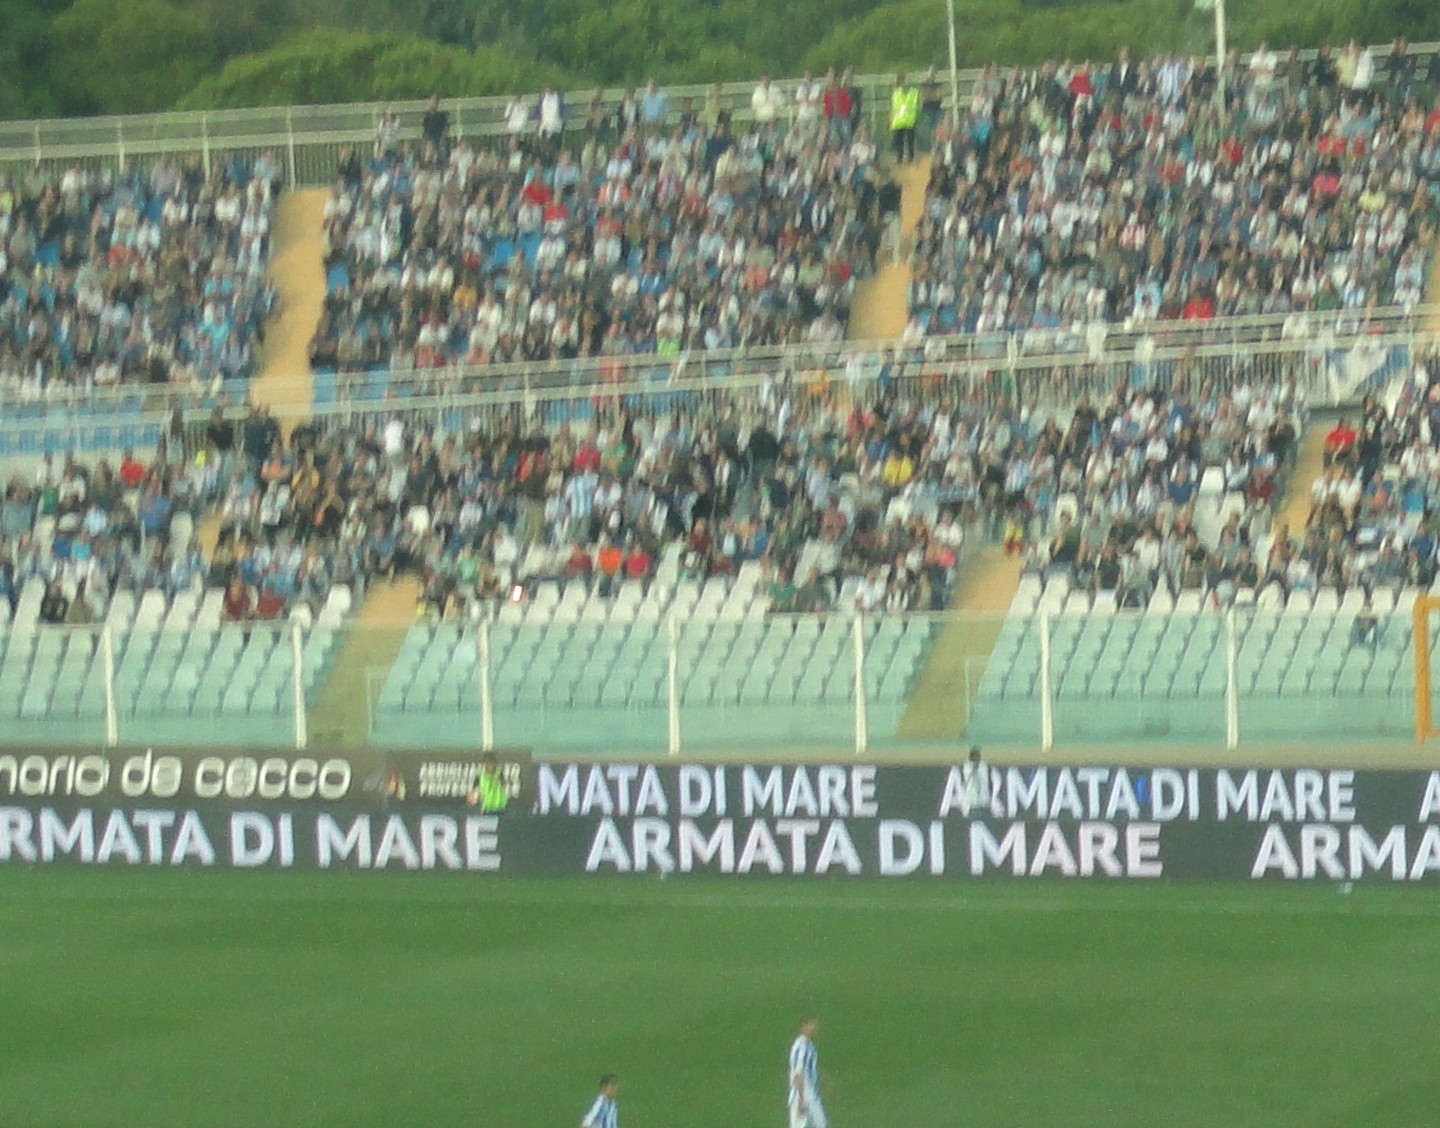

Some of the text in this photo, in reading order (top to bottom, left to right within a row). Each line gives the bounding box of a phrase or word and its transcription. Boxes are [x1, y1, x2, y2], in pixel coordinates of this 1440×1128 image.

[532, 762, 879, 818] MATA DI MARE
[1149, 767, 1200, 822] DI
[1215, 768, 1356, 822] MARE
[229, 810, 295, 867] DI
[315, 813, 501, 869] MARE
[585, 814, 1166, 877] ARMATA DI MARE
